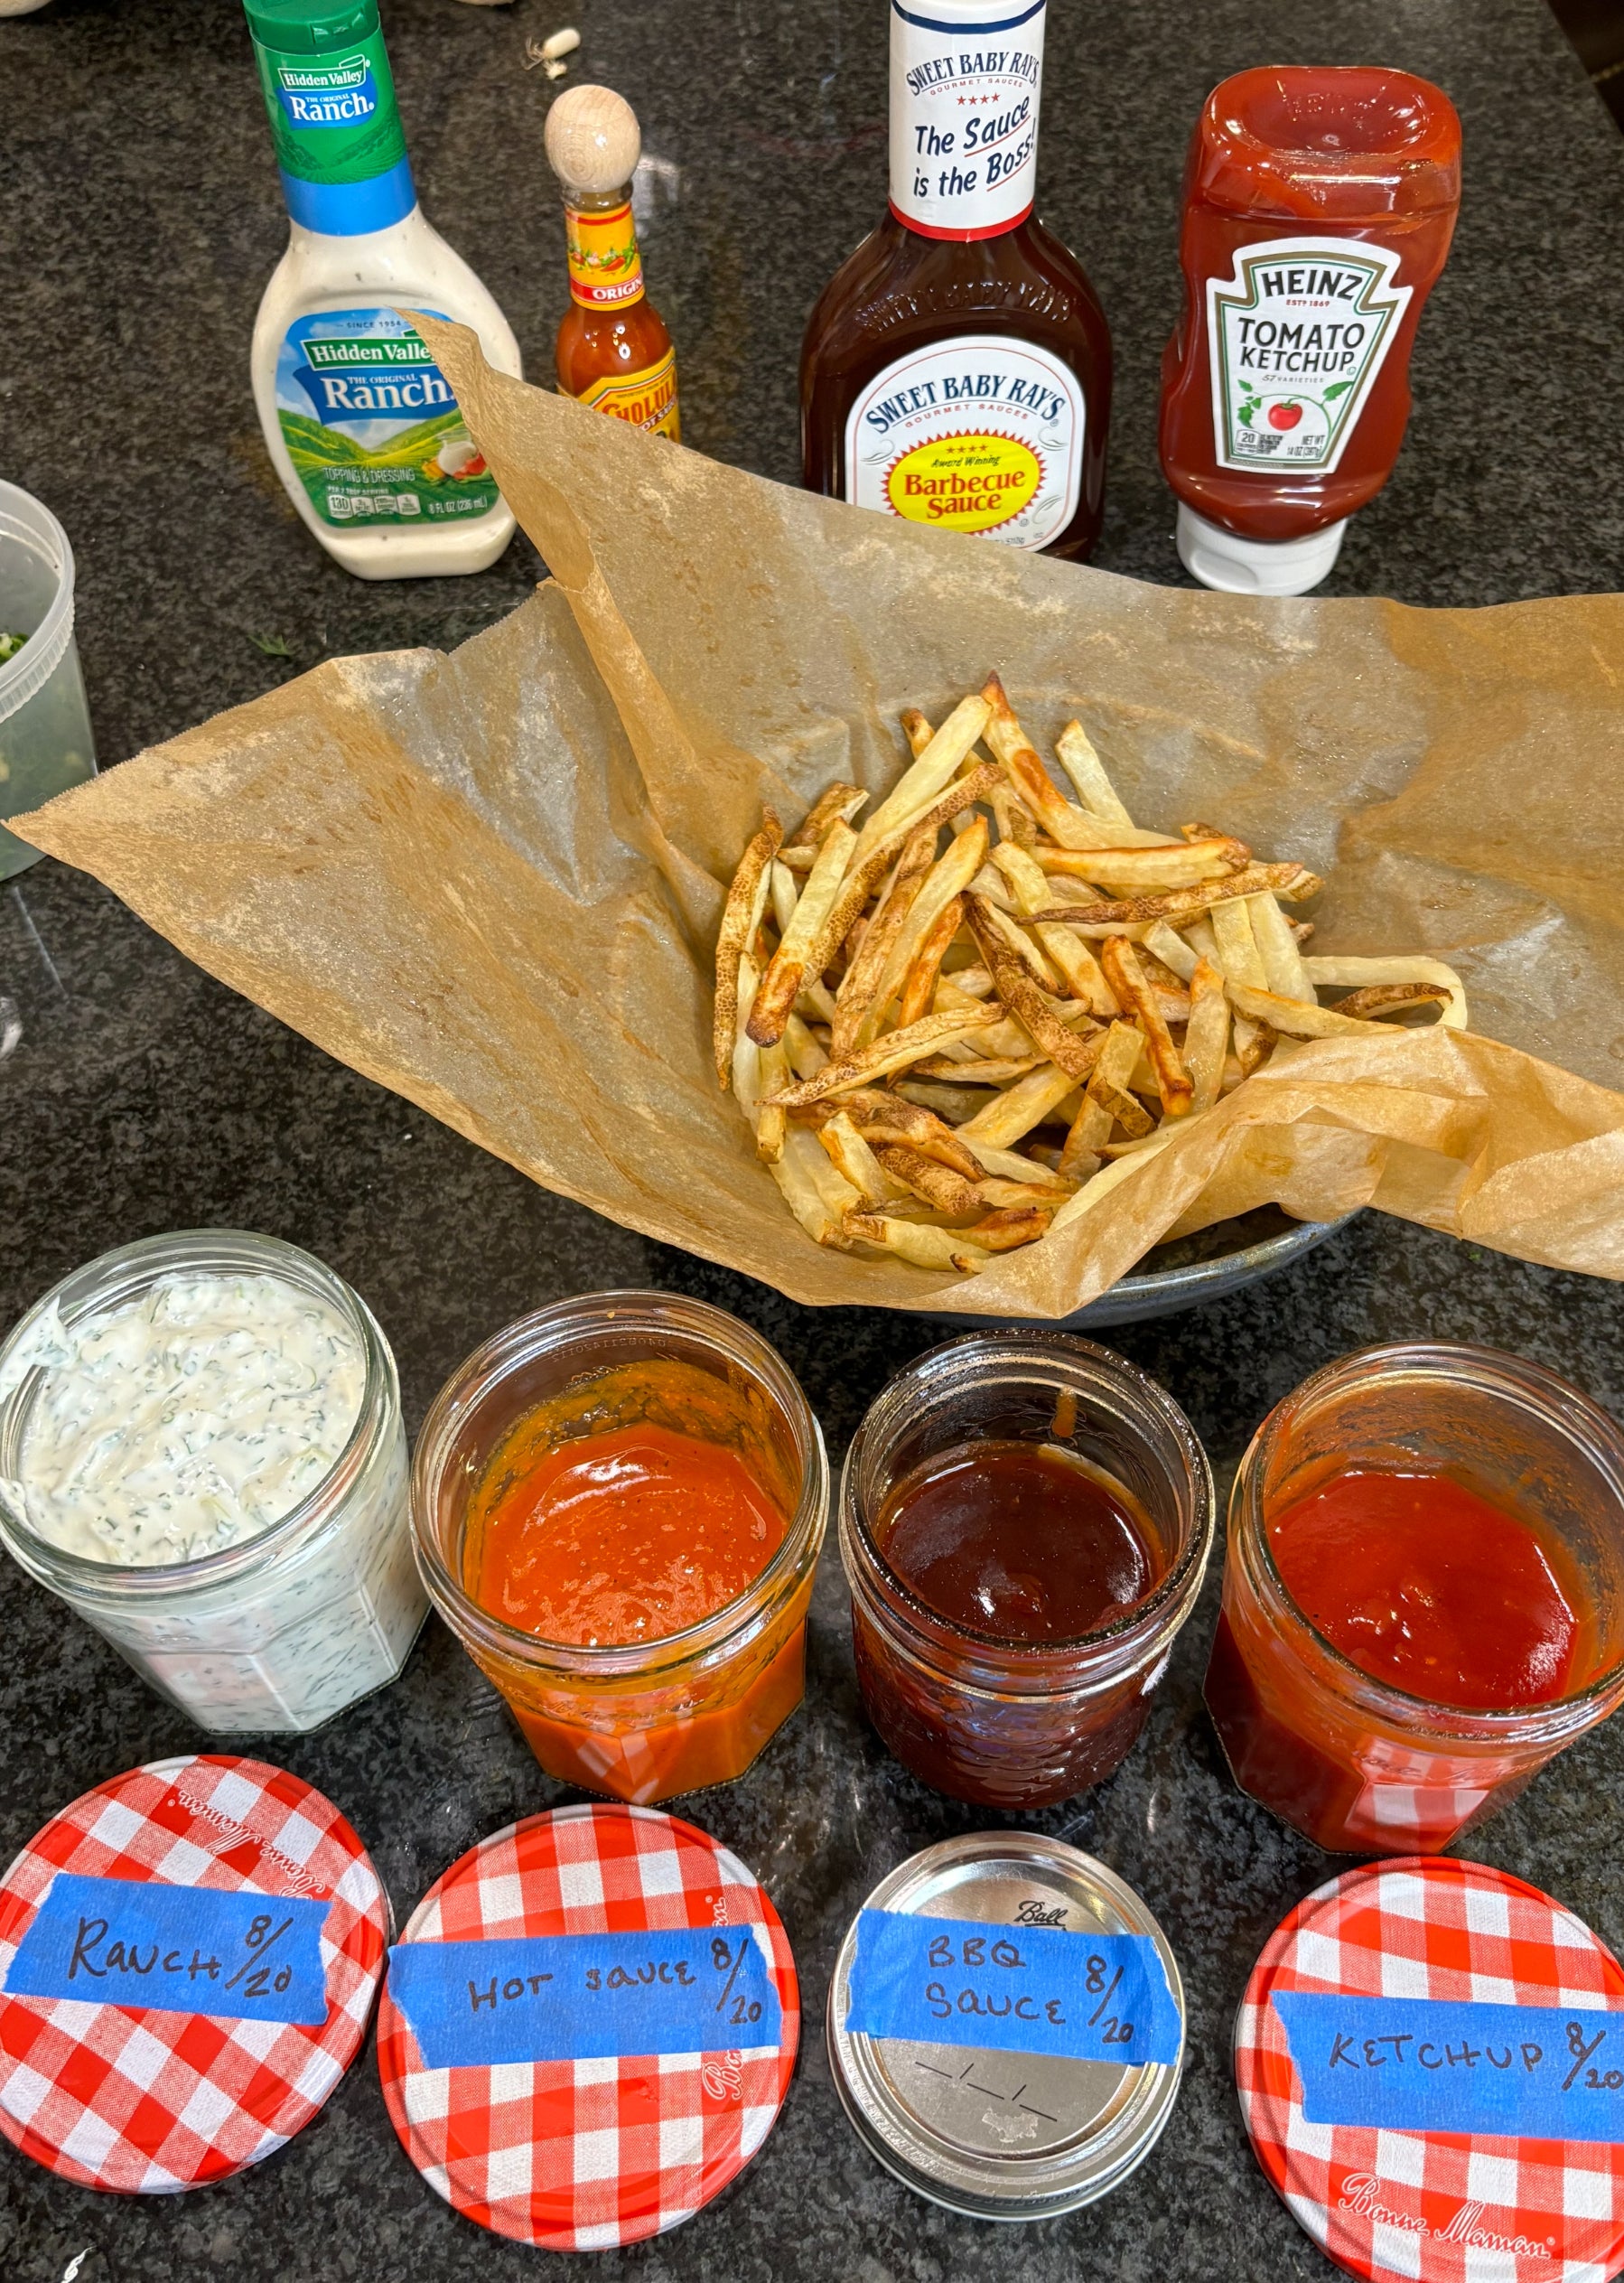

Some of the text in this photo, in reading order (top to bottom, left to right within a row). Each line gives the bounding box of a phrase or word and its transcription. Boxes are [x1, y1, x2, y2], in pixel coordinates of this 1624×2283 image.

[283, 70, 363, 87] Hidden Valley
[906, 51, 1040, 97] SWEET BABY RAY'S
[929, 78, 1023, 96] GOURMET SAUCES
[914, 96, 1030, 156] The Sauce
[913, 117, 1037, 197] is the Boss!
[1261, 269, 1363, 301] HEINZ
[1309, 299, 1330, 307] 1869
[378, 320, 402, 328] 1954
[1237, 317, 1365, 351] TOMATO
[311, 342, 435, 362] Hidden Valle
[1239, 346, 1355, 373] KETCHUP
[347, 373, 418, 385] THE ORIGINAL
[1262, 374, 1325, 384] 57 VARIETIES
[866, 375, 1067, 435] SWEET BABY RAY'S
[904, 403, 1029, 429] GOURMET SAUCES
[1241, 432, 1255, 444] 20
[931, 454, 1003, 468] Award Winning
[323, 467, 415, 483] TOPPING & DRESSING
[903, 470, 1026, 496] Barbecue
[331, 497, 349, 510] 130
[926, 492, 1003, 519] Sauce
[178, 1790, 261, 1856] Maman
[1013, 1900, 1069, 1925] Ball
[928, 1935, 1027, 1968] BBQ
[468, 1973, 554, 2013] HOT
[1329, 2032, 1544, 2072] KETCHUP
[1338, 2172, 1551, 2260] Bonne Maman
